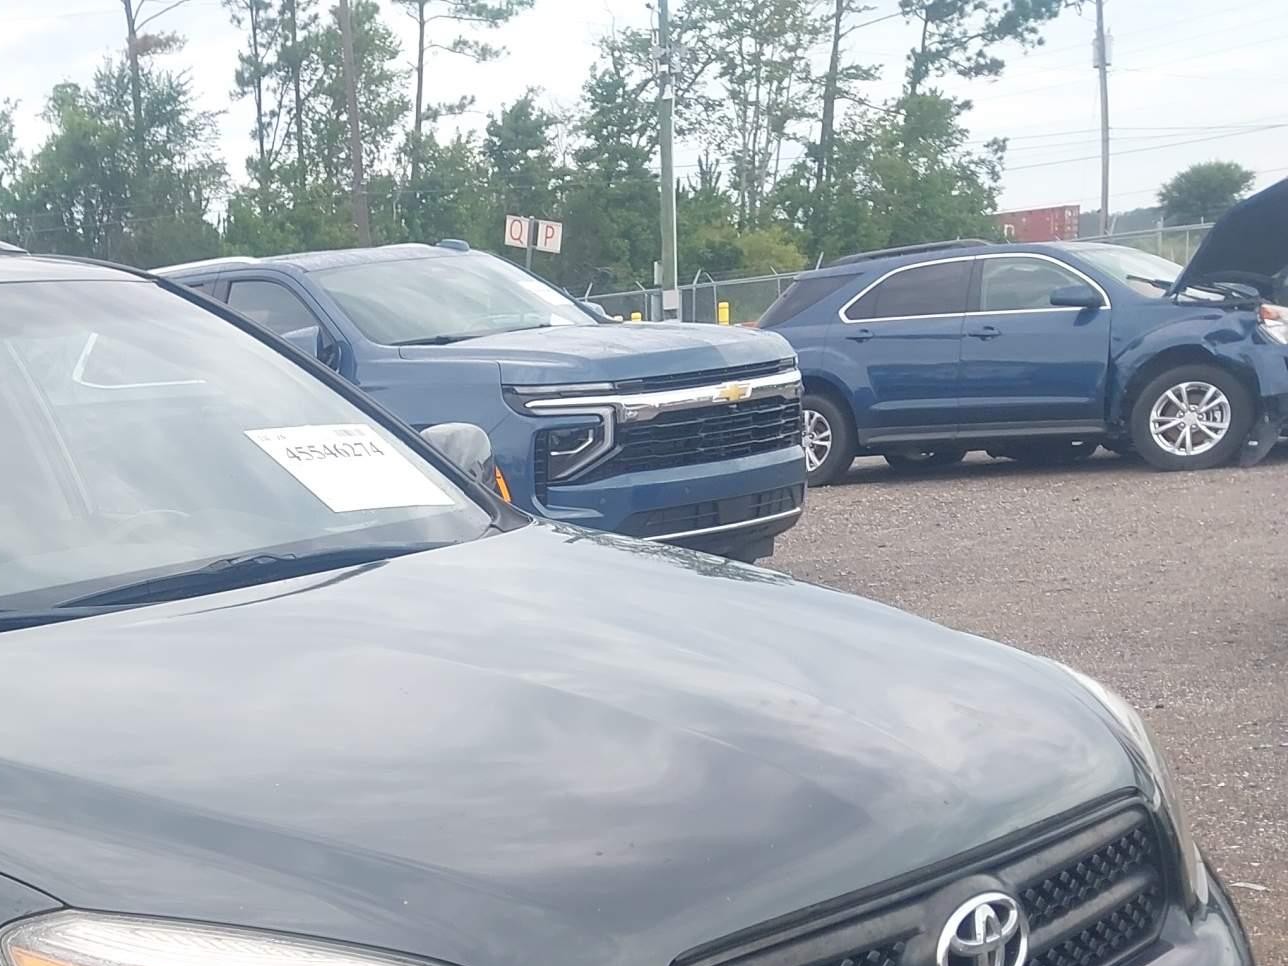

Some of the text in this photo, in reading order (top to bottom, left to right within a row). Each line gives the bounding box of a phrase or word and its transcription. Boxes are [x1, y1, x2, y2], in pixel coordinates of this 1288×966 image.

[510, 219, 524, 245] Q
[544, 225, 556, 247] P
[285, 441, 385, 462] 45546274
